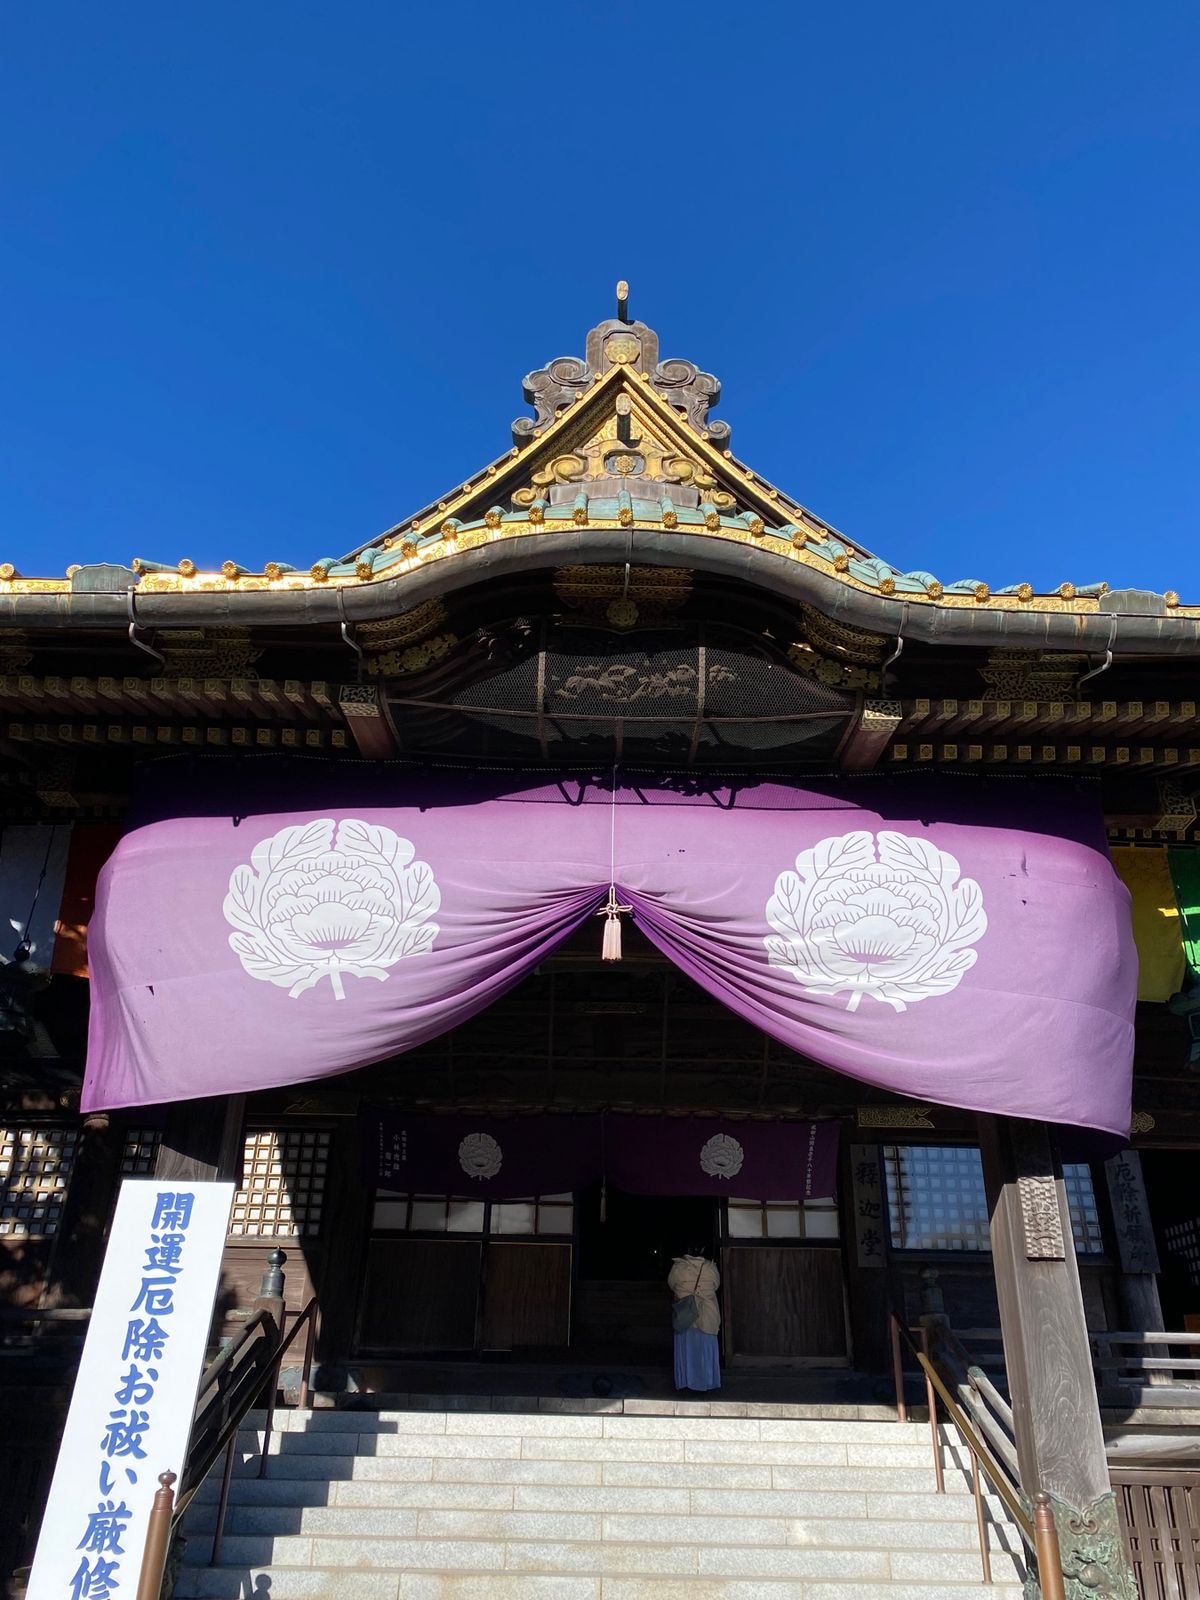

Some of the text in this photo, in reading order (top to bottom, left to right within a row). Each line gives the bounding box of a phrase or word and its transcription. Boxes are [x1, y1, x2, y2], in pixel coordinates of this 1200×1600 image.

[69, 1191, 195, 1600] 開運厄除お祓い厳修
